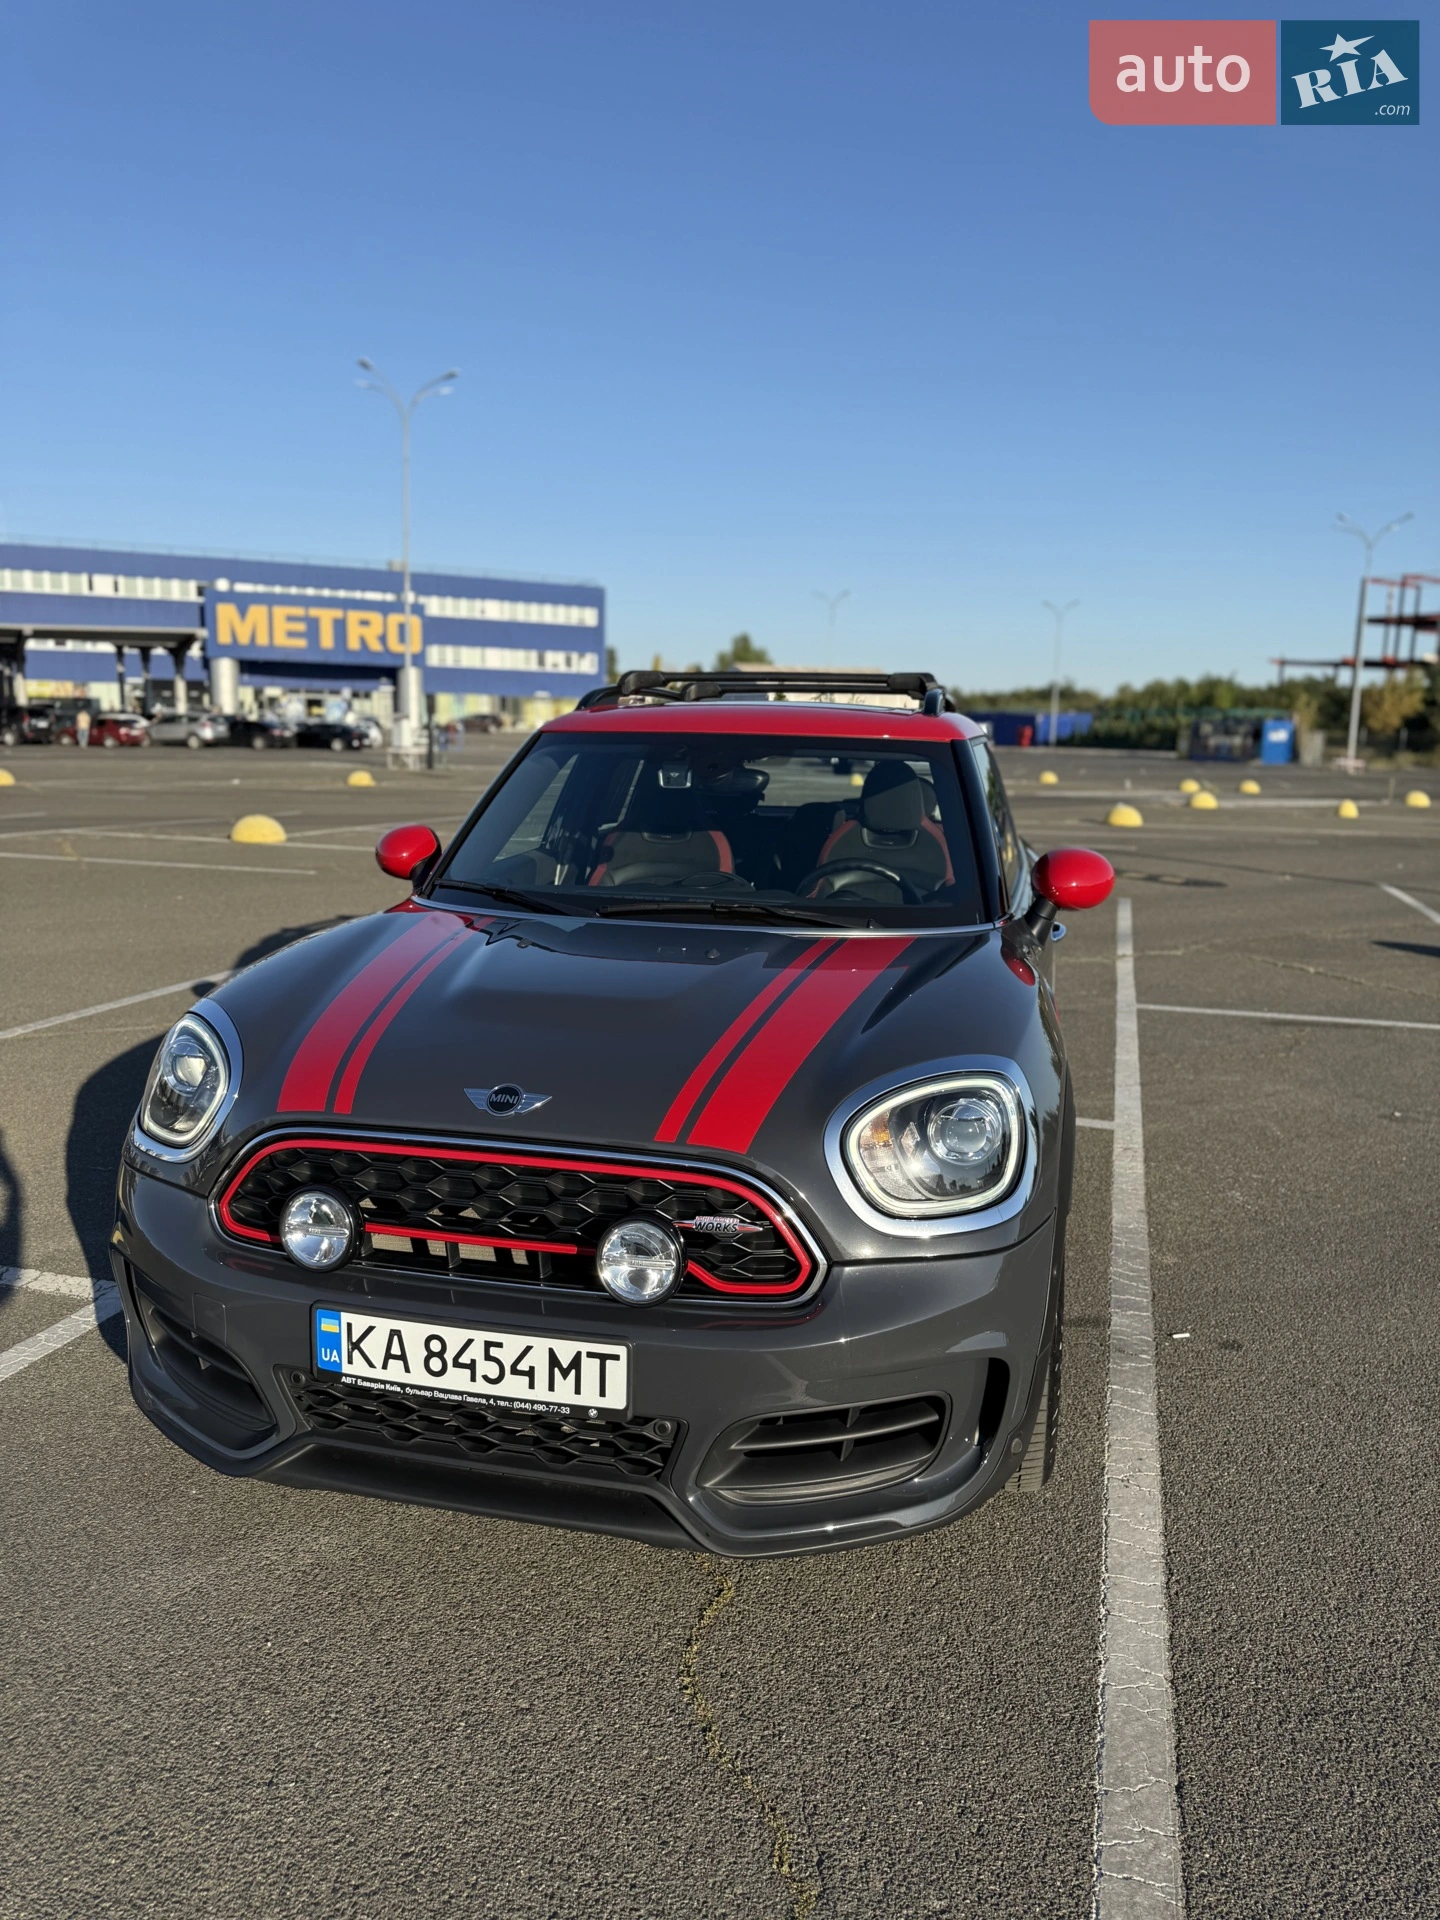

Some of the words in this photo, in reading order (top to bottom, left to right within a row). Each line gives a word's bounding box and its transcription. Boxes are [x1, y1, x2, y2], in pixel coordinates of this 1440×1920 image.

[215, 602, 423, 654] METRO
[489, 1093, 519, 1104] MINI
[695, 1221, 738, 1232] WORKS
[321, 1347, 340, 1363] UA
[347, 1322, 411, 1373] KA
[423, 1334, 535, 1389] 8454
[548, 1347, 620, 1397] MT
[341, 1376, 356, 1384] АВТ
[357, 1379, 384, 1390] Баварія
[405, 1387, 433, 1397] бульвар
[434, 1391, 462, 1401] Вацлава
[463, 1395, 488, 1405] Гавела,
[489, 1398, 496, 1406] 4,
[513, 1401, 531, 1410] (044)
[532, 1403, 570, 1414] 490-77-33
